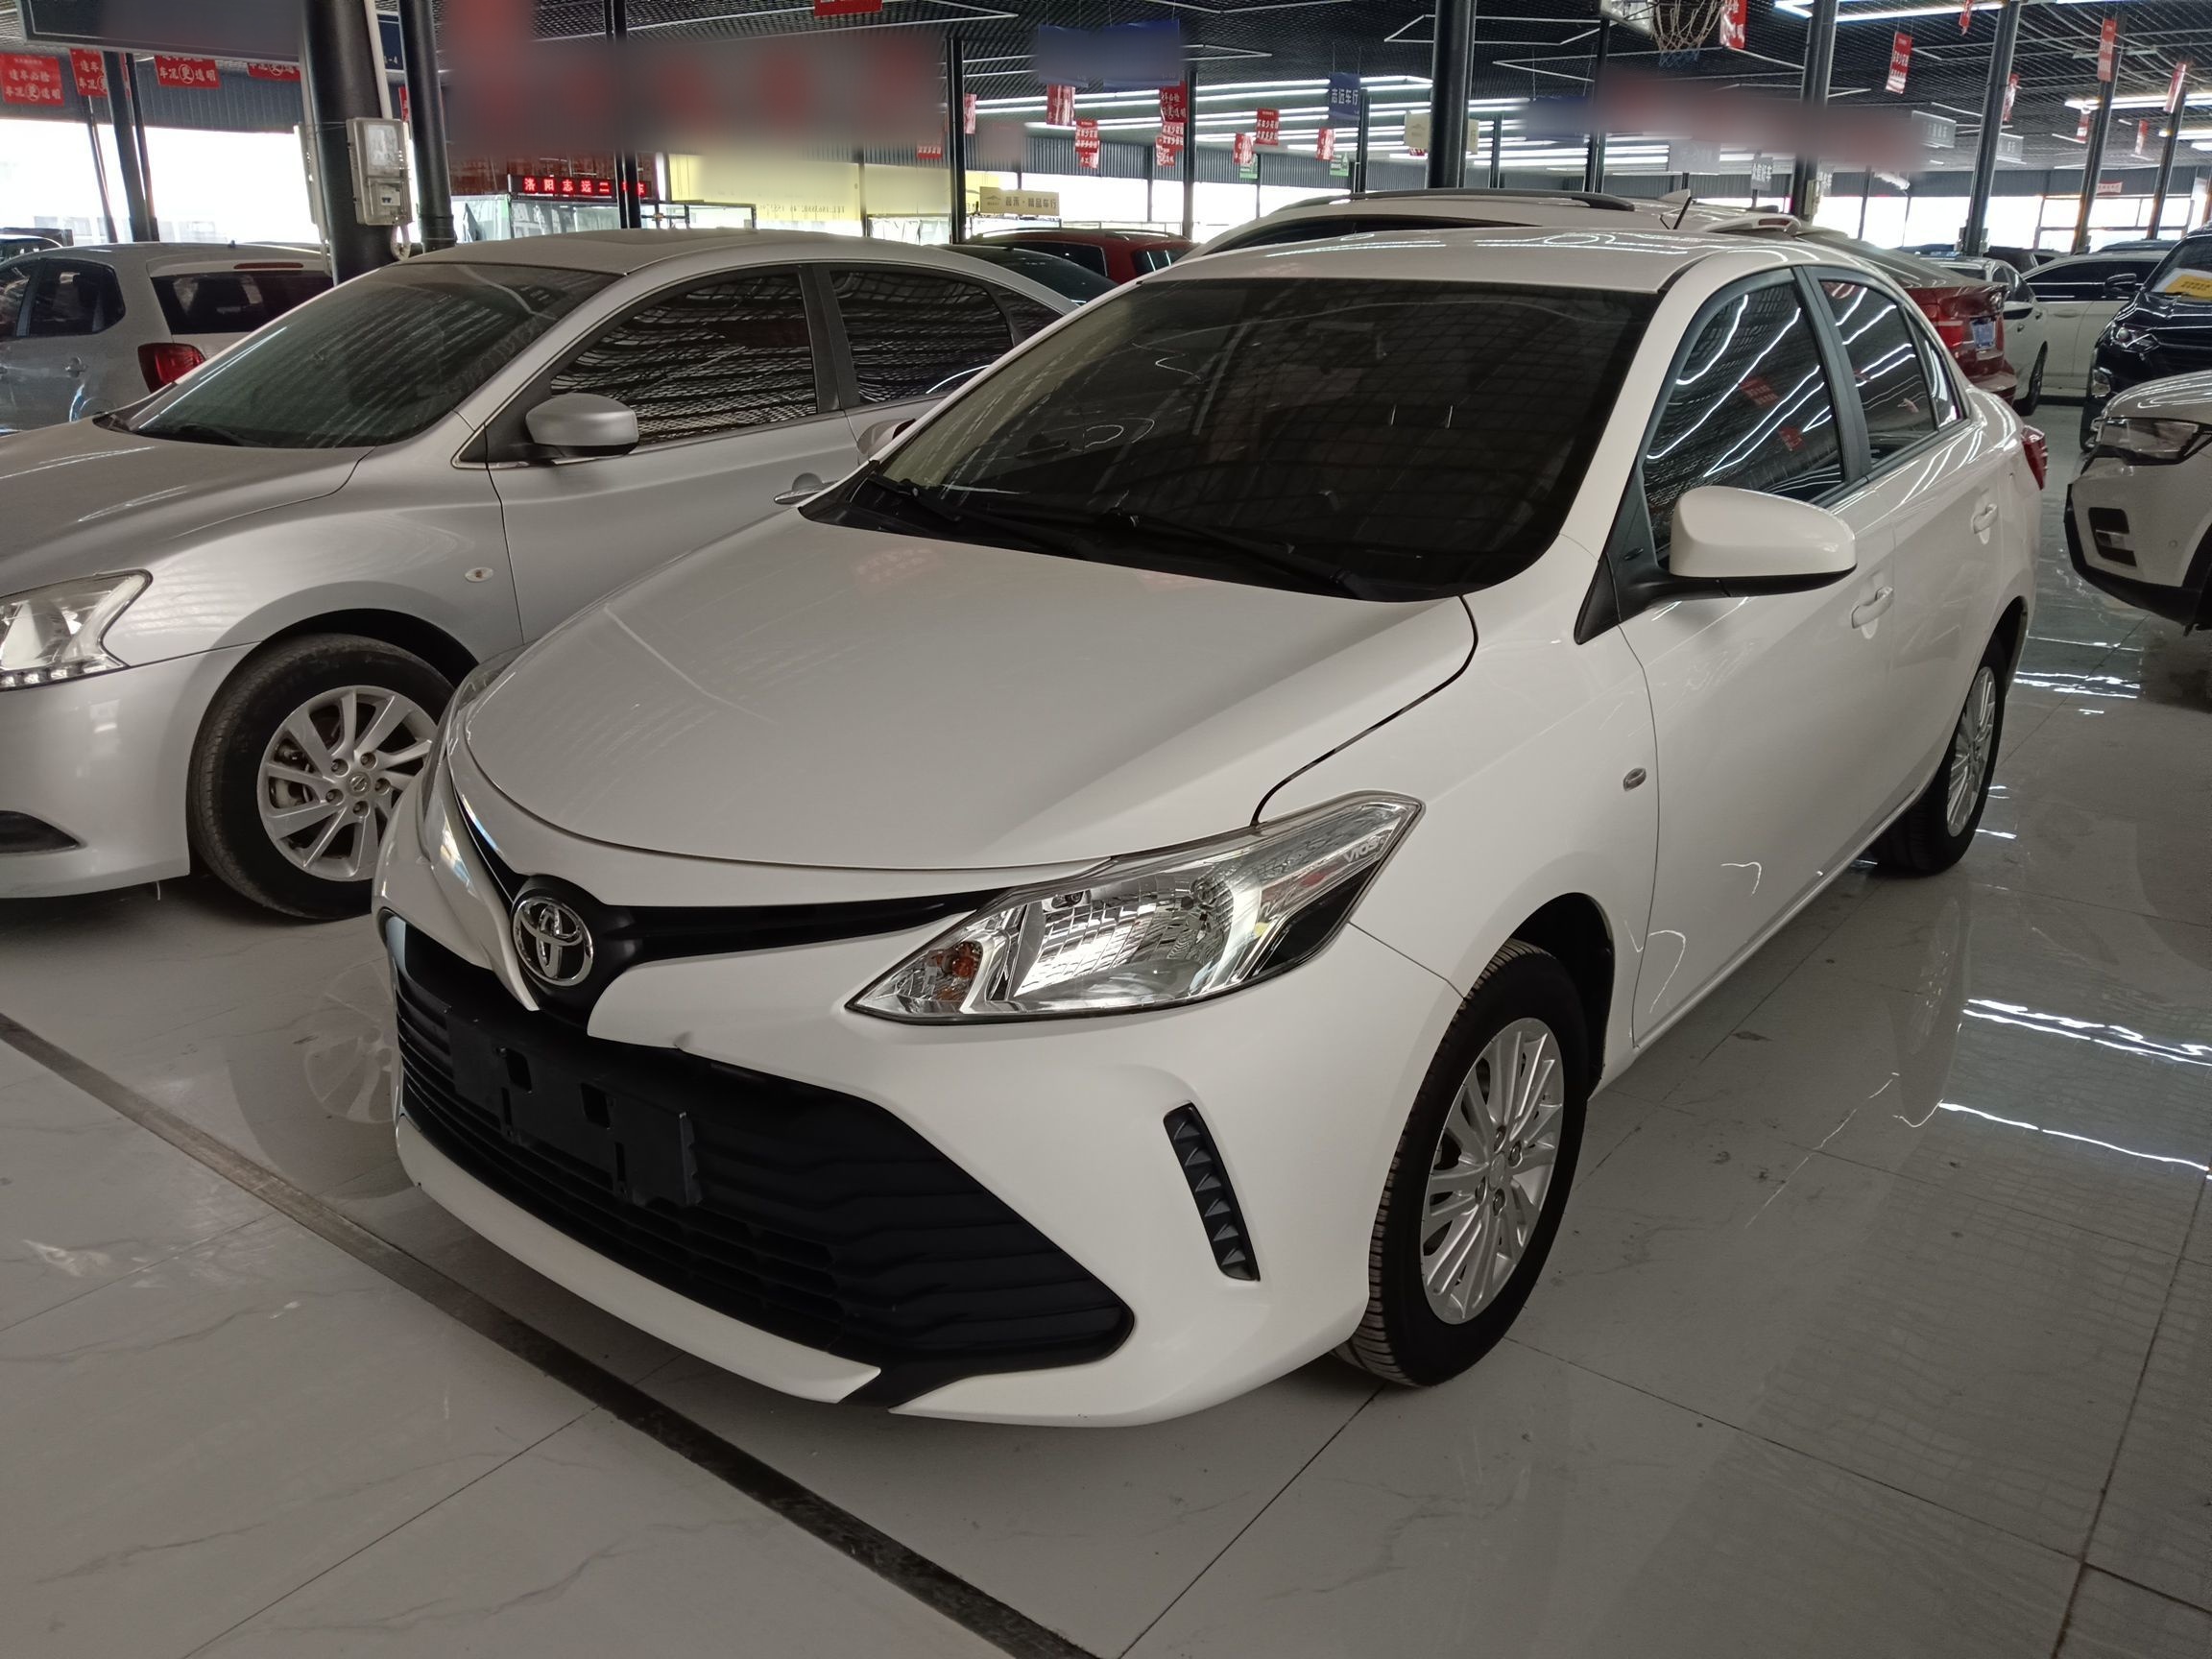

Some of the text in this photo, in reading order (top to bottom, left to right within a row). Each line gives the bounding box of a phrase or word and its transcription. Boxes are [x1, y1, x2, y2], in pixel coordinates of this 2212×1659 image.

[524, 177, 646, 196] 洛阳志远二车
